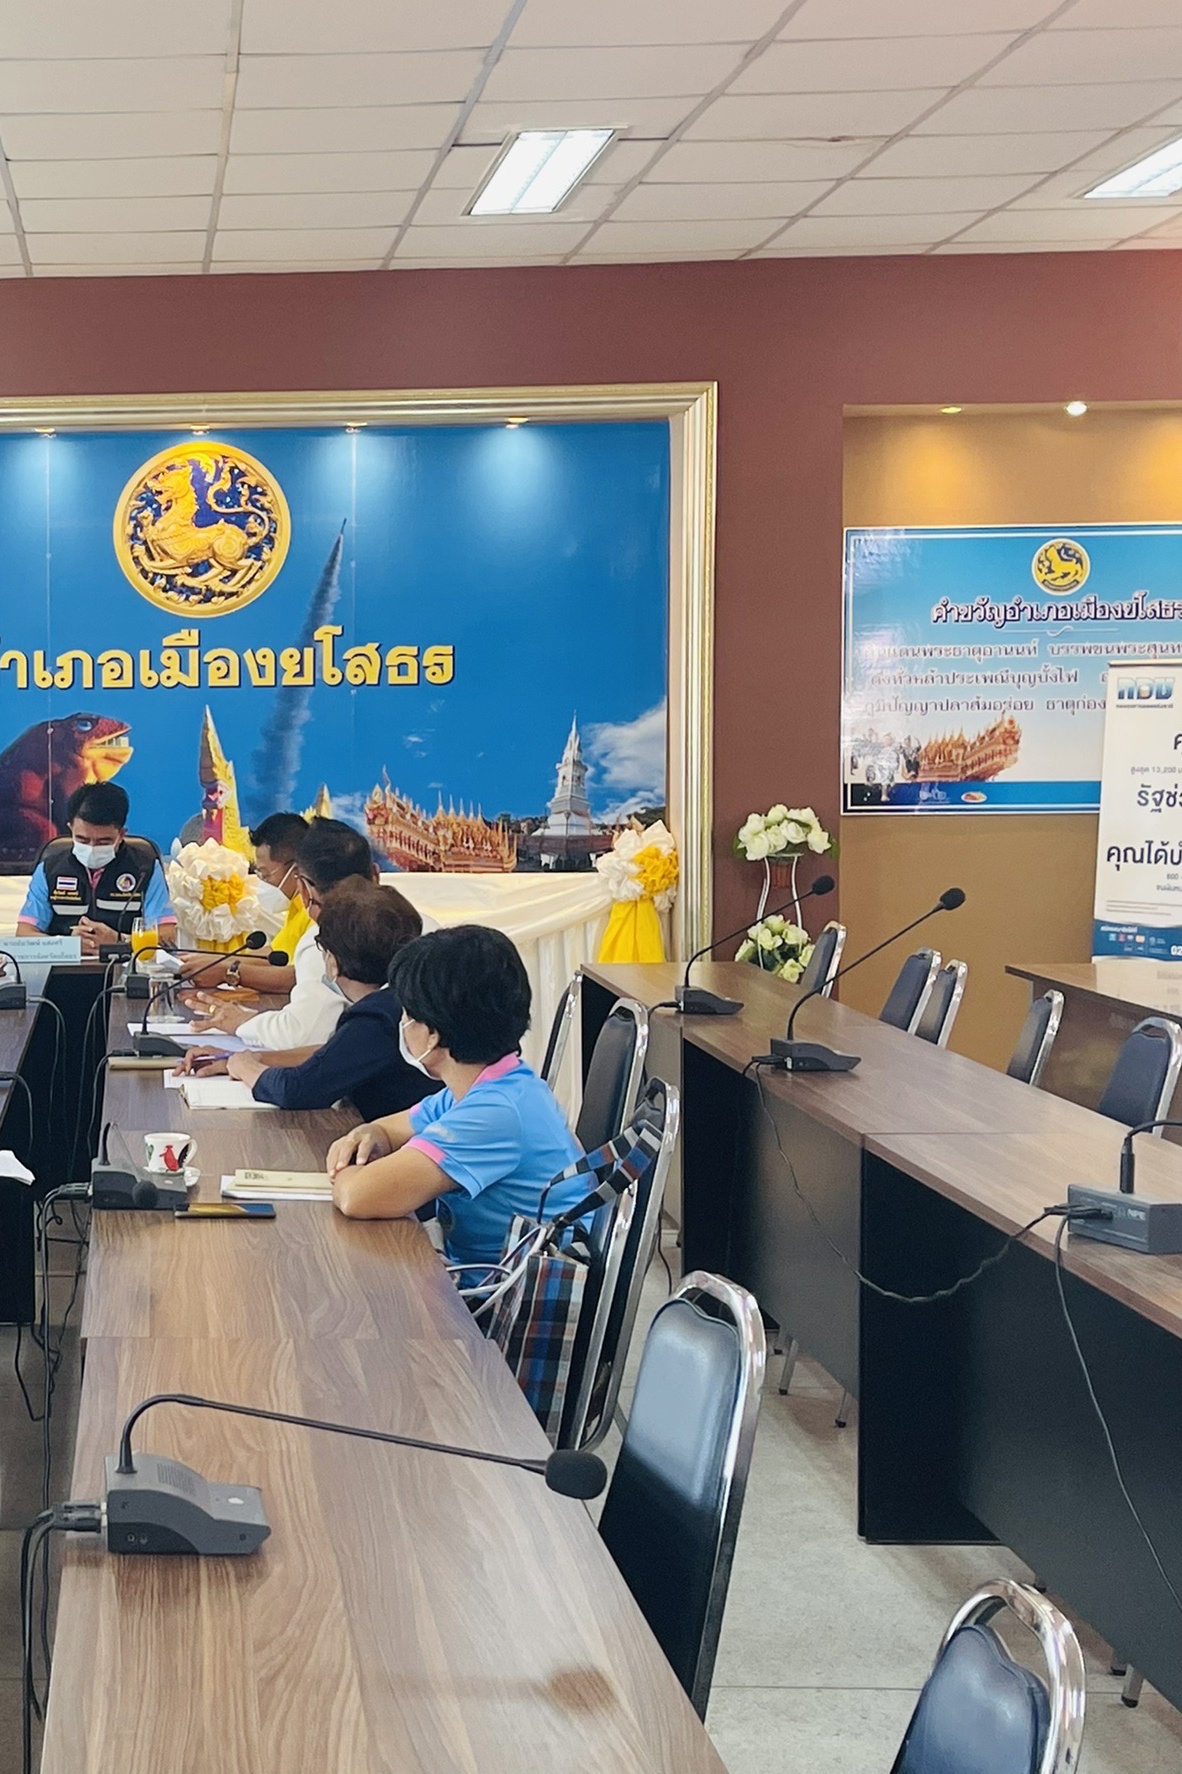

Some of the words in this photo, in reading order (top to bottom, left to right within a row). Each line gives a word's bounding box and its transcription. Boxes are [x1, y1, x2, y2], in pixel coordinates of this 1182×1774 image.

[865, 640, 1039, 662] นแดนพระธาตุอานนท์
